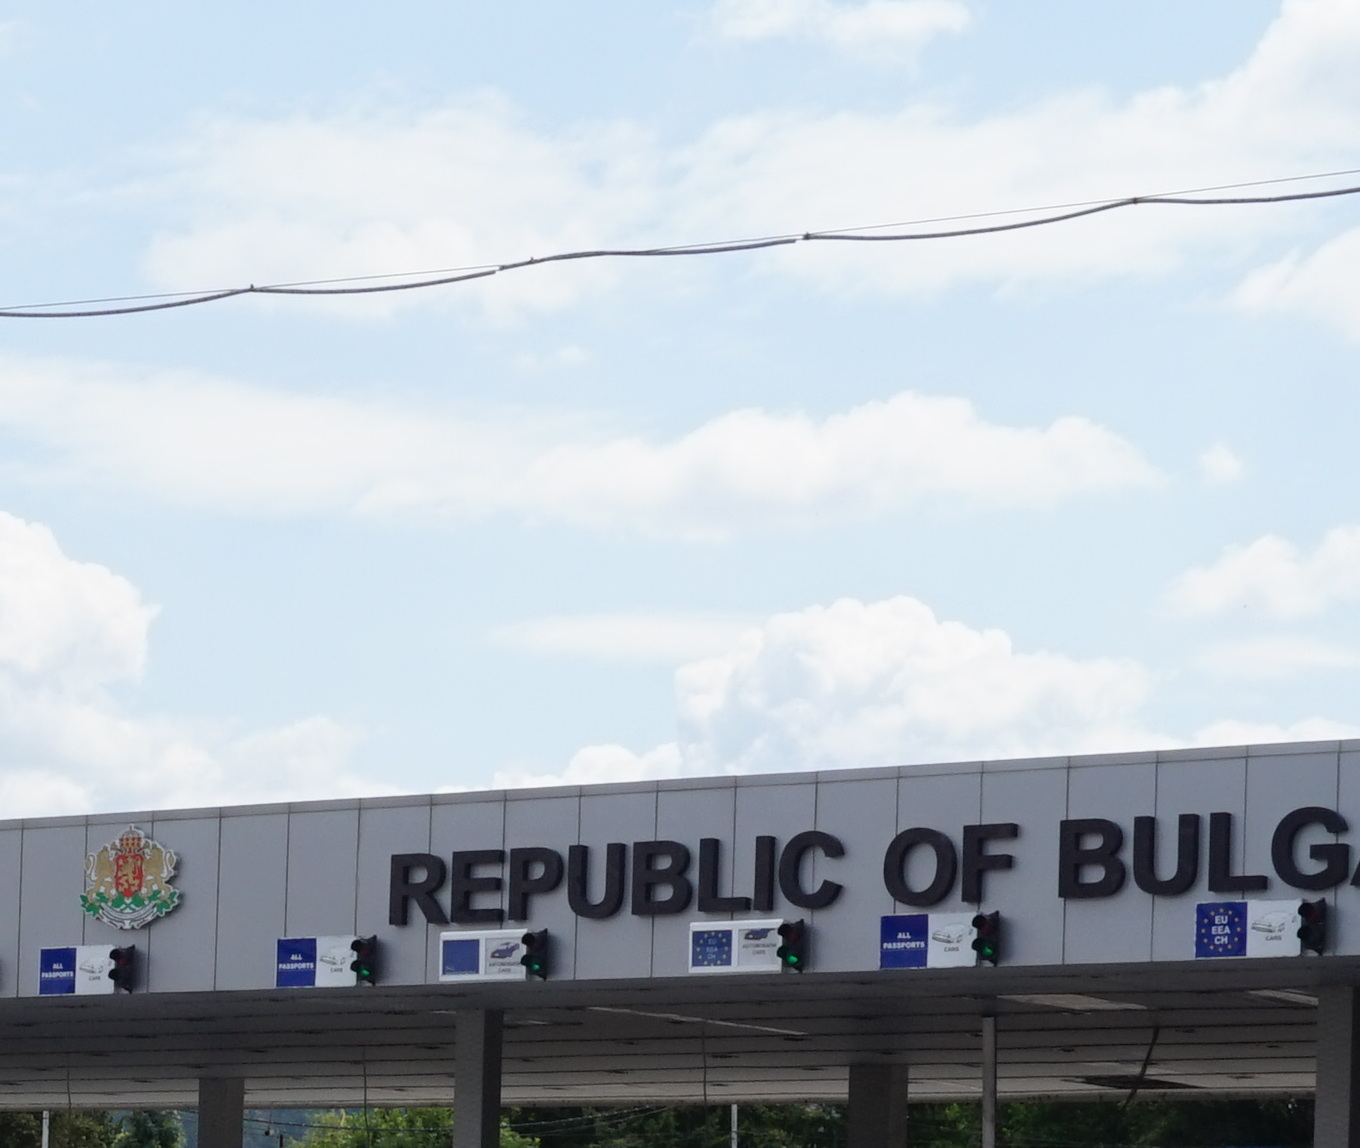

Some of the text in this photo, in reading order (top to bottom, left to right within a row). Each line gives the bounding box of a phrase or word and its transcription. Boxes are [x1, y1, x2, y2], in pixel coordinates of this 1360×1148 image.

[389, 830, 845, 926] REPUBLIC
[883, 823, 1019, 908] OF
[1214, 915, 1228, 924] EU
[1211, 925, 1231, 935] EEA
[883, 941, 925, 949] PASSPORTS
[1214, 936, 1228, 945] CH
[278, 962, 314, 970] PASSPORTS
[41, 971, 73, 979] PASSPORTS
